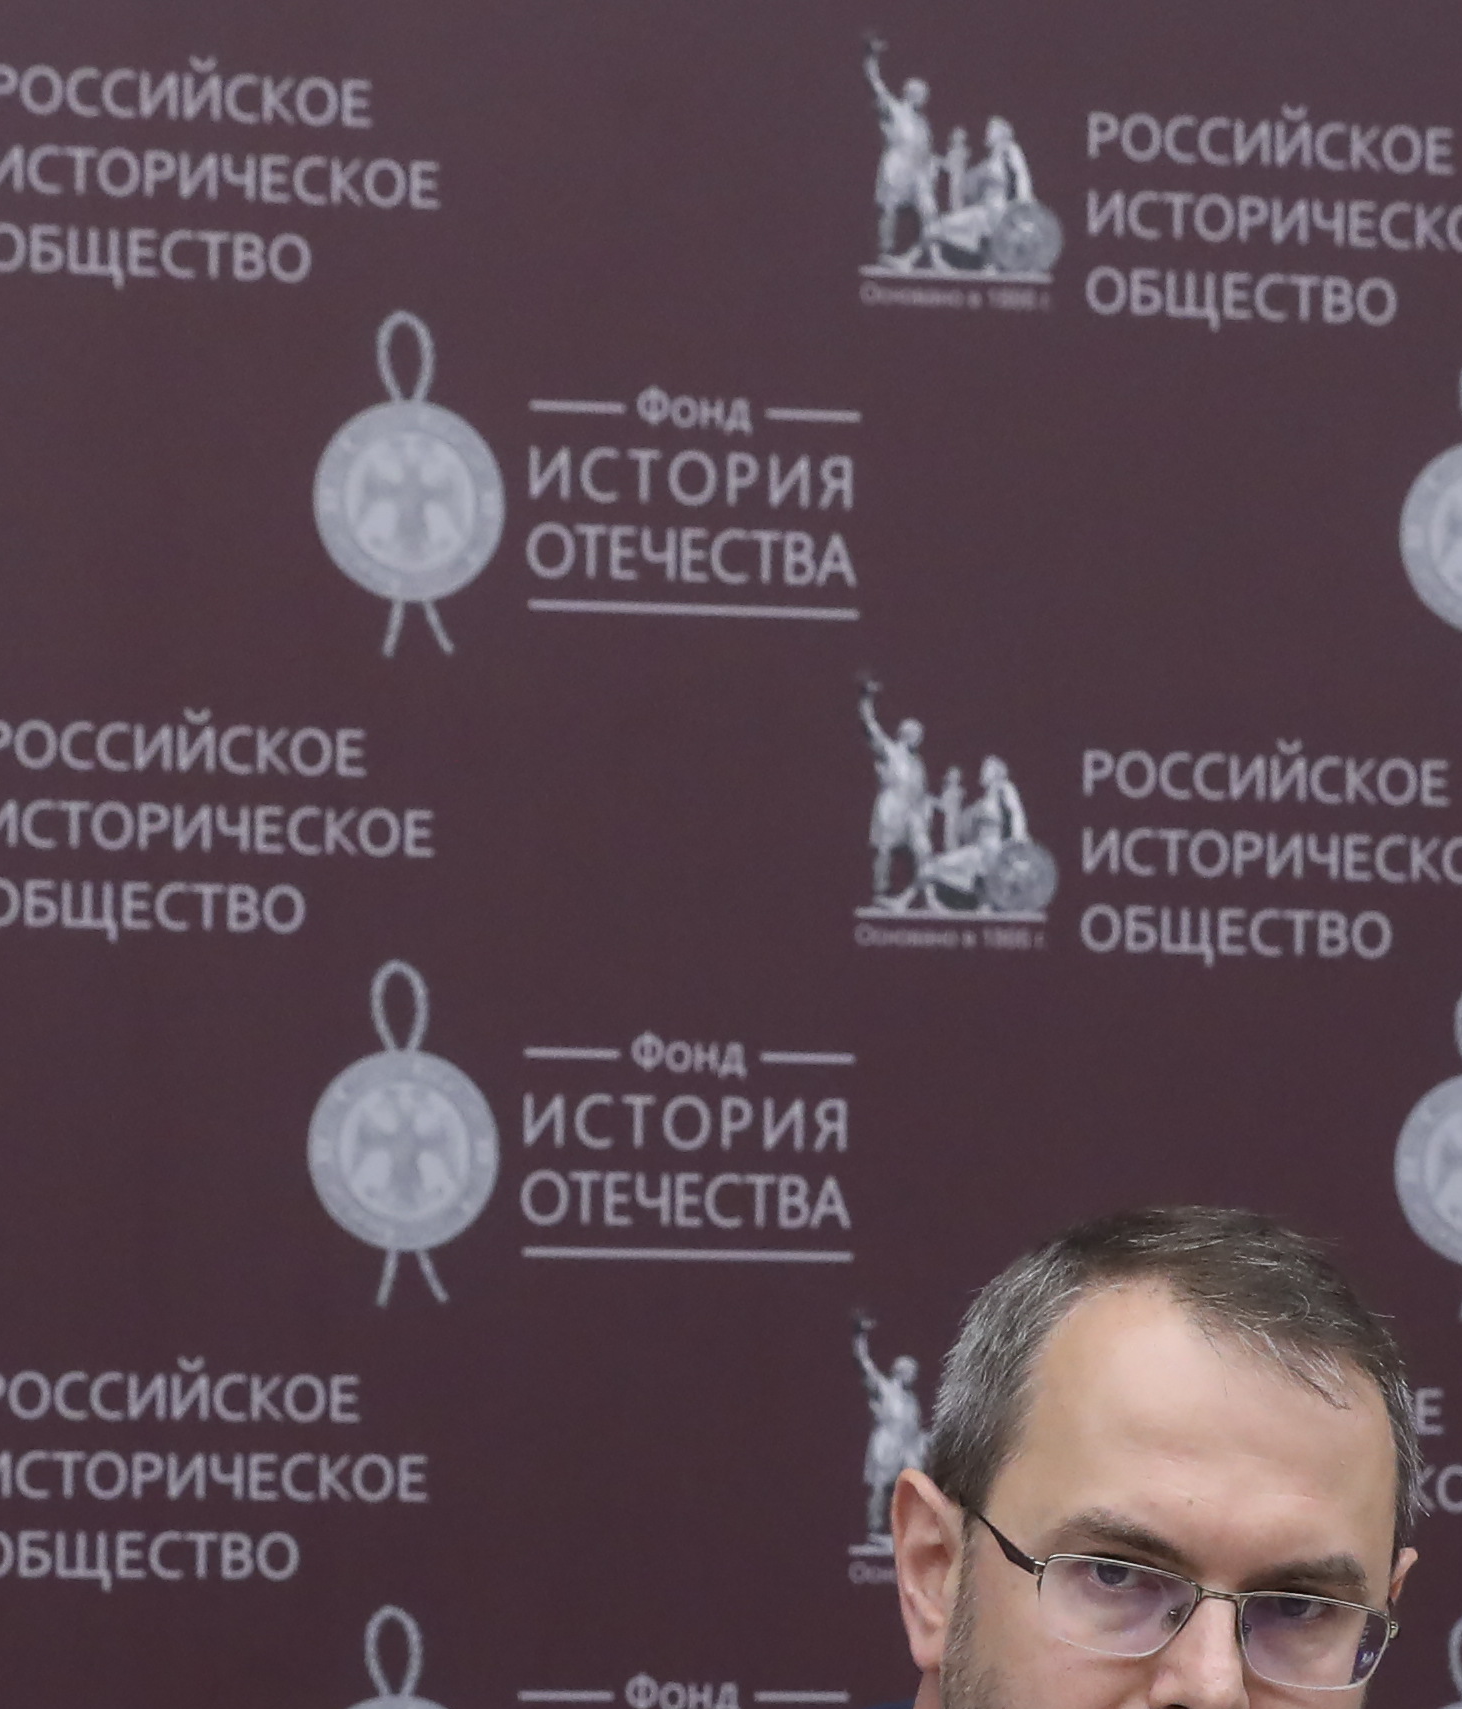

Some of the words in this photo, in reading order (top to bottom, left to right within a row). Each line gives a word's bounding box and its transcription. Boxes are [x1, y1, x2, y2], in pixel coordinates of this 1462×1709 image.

[1088, 105, 1453, 175] РОССИЙСКОЕ
[1086, 266, 1397, 331] ОБЩЕСТВО
[637, 386, 752, 434] Фонд
[529, 446, 853, 509] ИСТОРИЯ
[526, 522, 856, 586] ОТЕЧЕСТВА
[1083, 739, 1448, 807] РОССИЙСКОЕ
[1080, 904, 1392, 966] ОБЩЕСТВО
[631, 1031, 747, 1078] Фонд
[523, 1093, 847, 1151] ИСТОРИЯ
[520, 1170, 850, 1228] ОТЕЧЕСТВА
